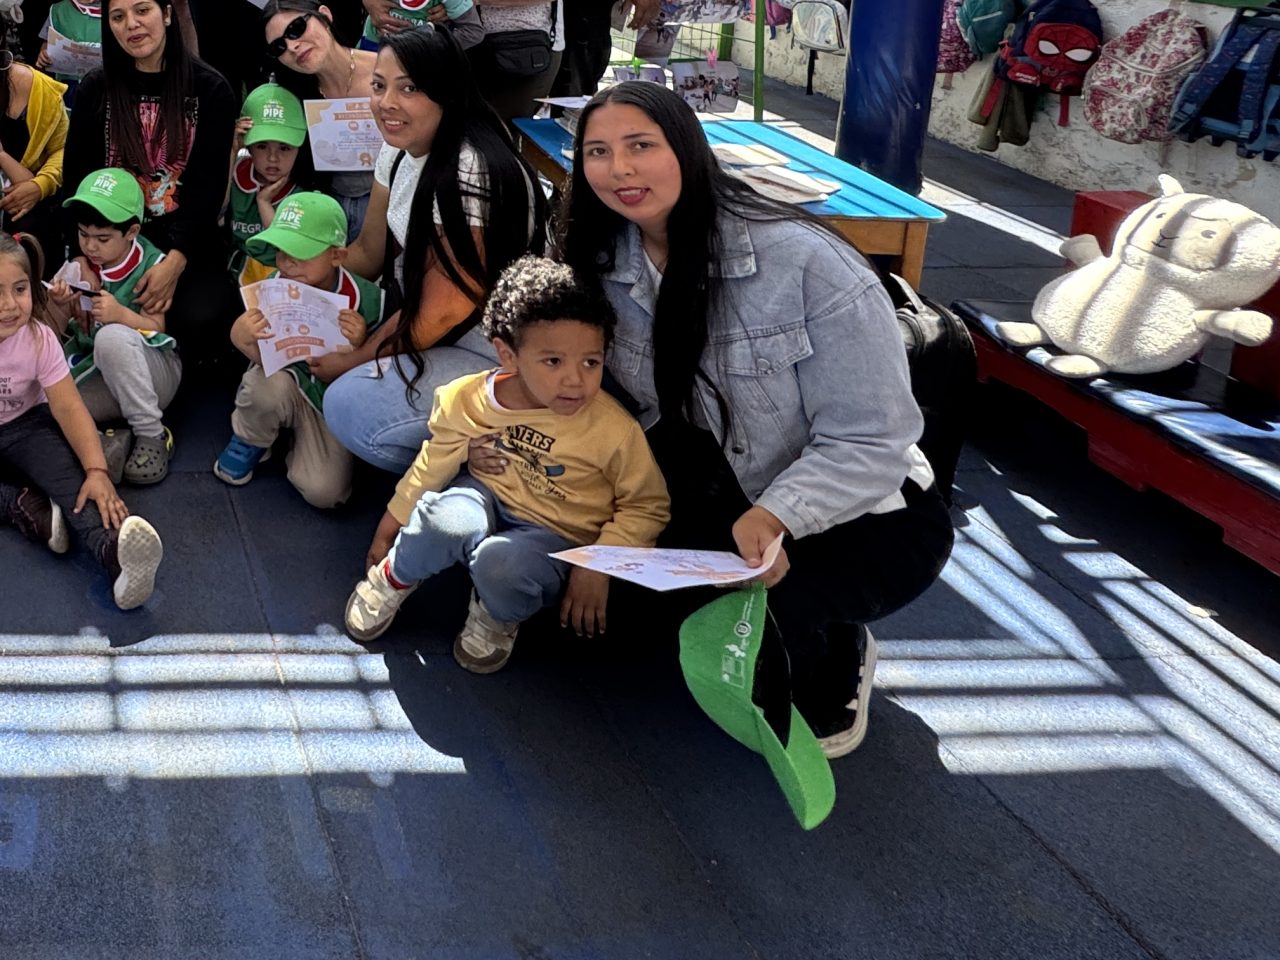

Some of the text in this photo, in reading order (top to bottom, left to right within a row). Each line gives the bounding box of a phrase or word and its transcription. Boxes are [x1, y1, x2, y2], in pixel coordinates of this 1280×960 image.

[263, 107, 284, 118] PIPE
[93, 177, 113, 191] PIPE
[279, 210, 303, 223] PIPE
